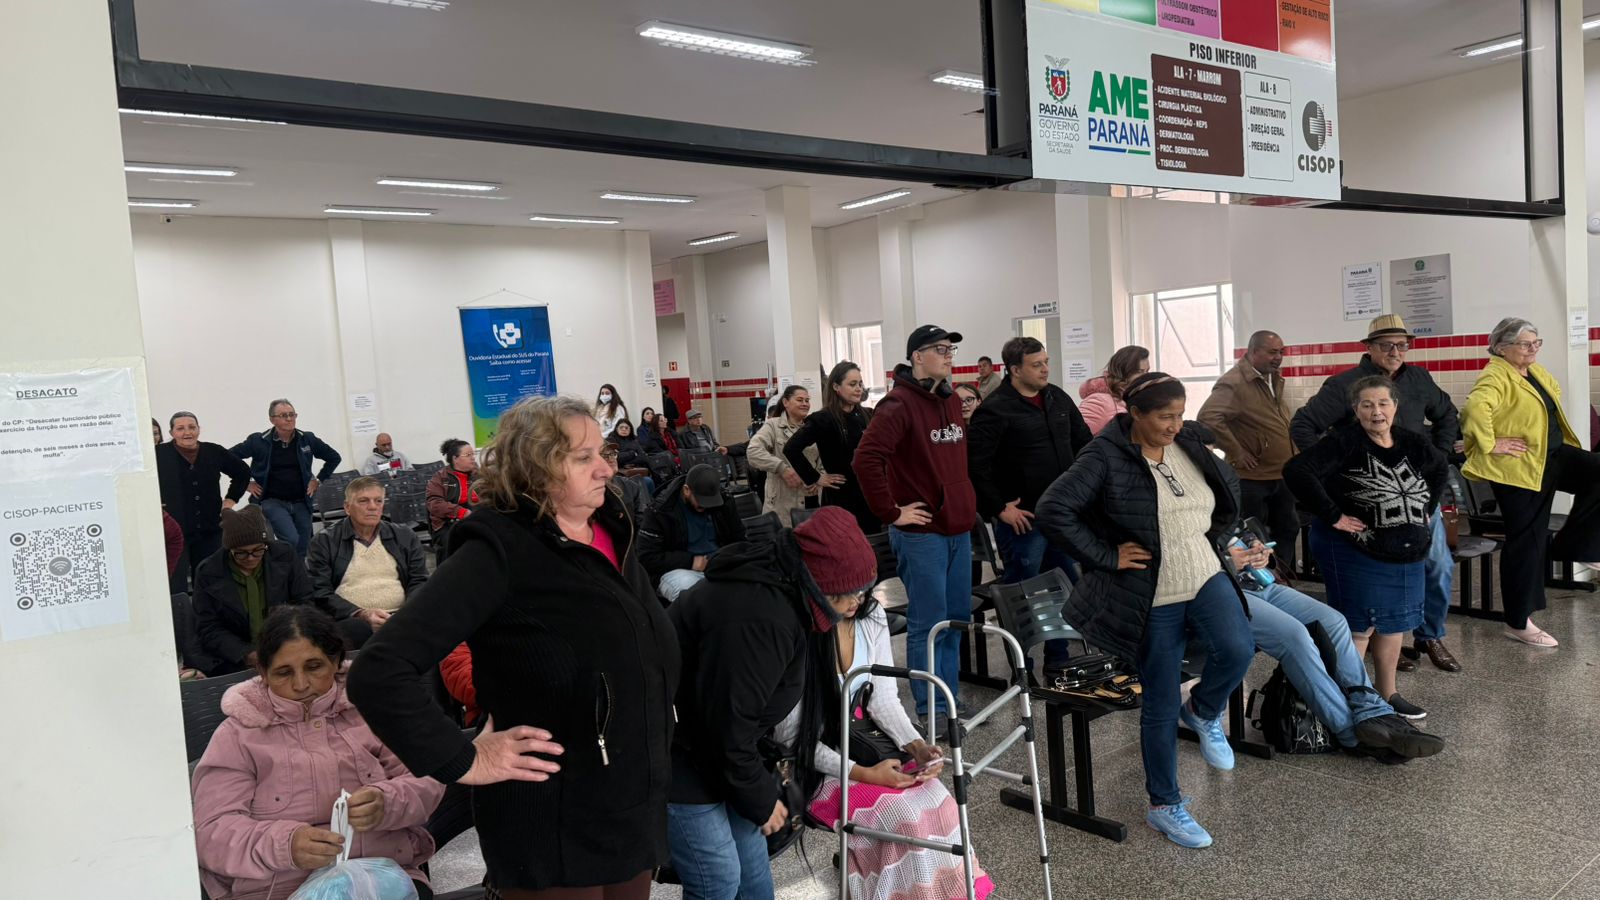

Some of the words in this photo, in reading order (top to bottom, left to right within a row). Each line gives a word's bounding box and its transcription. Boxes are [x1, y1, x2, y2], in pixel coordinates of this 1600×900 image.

[1190, 3, 1217, 17] OBSTÉTRICO
[1302, 6, 1308, 16] DE
[1308, 8, 1317, 19] ALTO
[1189, 42, 1212, 60] PISO
[1215, 47, 1257, 69] INFERIOR
[1173, 65, 1184, 79] ALA
[1188, 68, 1193, 80] 7
[1197, 69, 1222, 86] MARROM
[1260, 81, 1269, 93] ALA
[1088, 70, 1149, 120] AME
[1157, 85, 1180, 97] ACIDENTE
[1181, 88, 1203, 100] MATERIAL
[1203, 92, 1227, 104] BIOLÓGICO
[1039, 102, 1078, 118] PARANÁ
[1157, 100, 1180, 110] CIRURGIA
[1181, 102, 1202, 114] PLÁSTICA
[1249, 105, 1287, 120] ADMINISTRATIVO
[1039, 118, 1080, 132] GOVERNO
[1158, 115, 1193, 128] COORDENAÇÃO
[1196, 120, 1208, 129] NEPS
[1039, 129, 1050, 138] DO
[1052, 130, 1080, 142] ESTADO
[1088, 117, 1151, 148] PARANÁ
[1159, 129, 1195, 141] DERMATOLOGIA
[1250, 122, 1270, 136] DIREÇÃO
[1271, 126, 1285, 137] GERAL
[1047, 140, 1073, 149] SECRETARIA
[1160, 144, 1174, 153] PROC.
[1174, 146, 1209, 157] DERMATOLOGIA
[1251, 140, 1280, 153] PRESIDÊNCIA
[1160, 159, 1187, 169] TISIOLOGIA
[1297, 154, 1335, 174] CISOP
[16, 387, 79, 399] DESACATO
[98, 412, 121, 420] público
[3, 501, 103, 519] CISOP-PACIENTES
